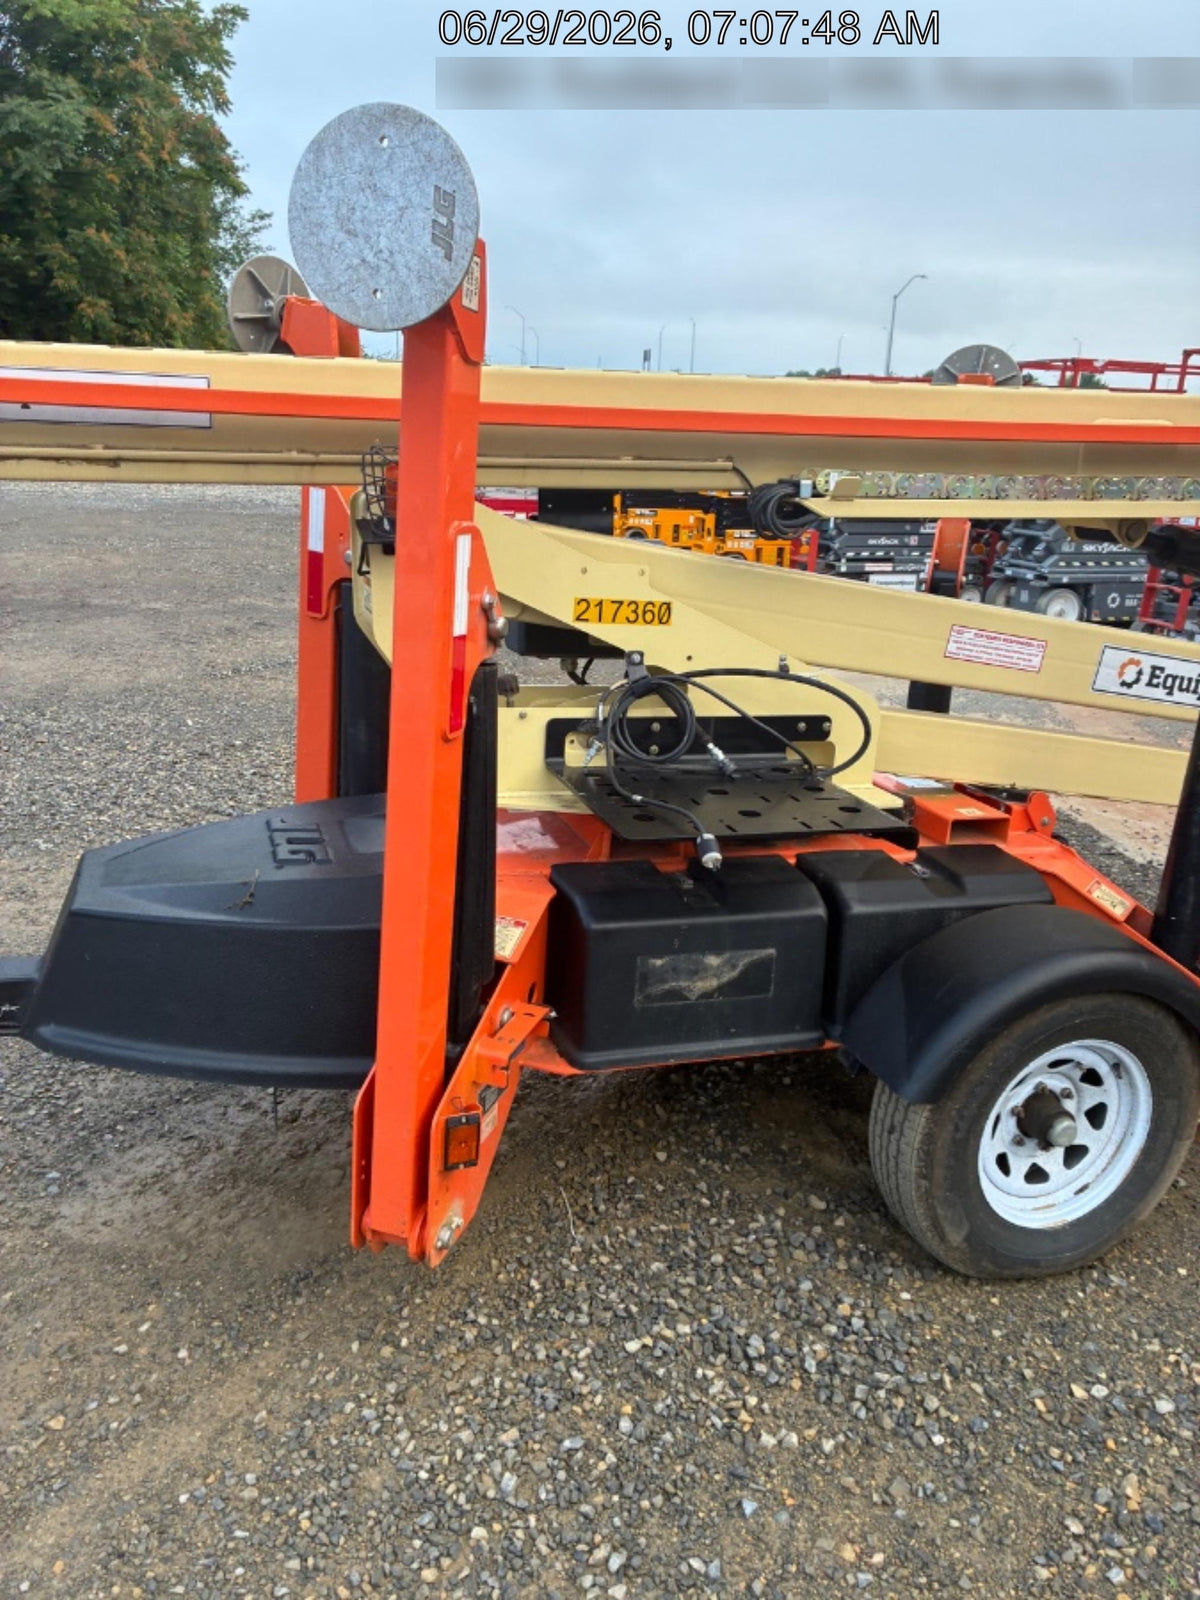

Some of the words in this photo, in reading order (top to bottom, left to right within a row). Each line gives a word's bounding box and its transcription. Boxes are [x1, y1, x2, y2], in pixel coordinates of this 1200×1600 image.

[431, 185, 456, 262] JLG
[575, 598, 672, 625] 217360
[1145, 664, 1200, 700] Equi
[266, 817, 333, 869] JLG
